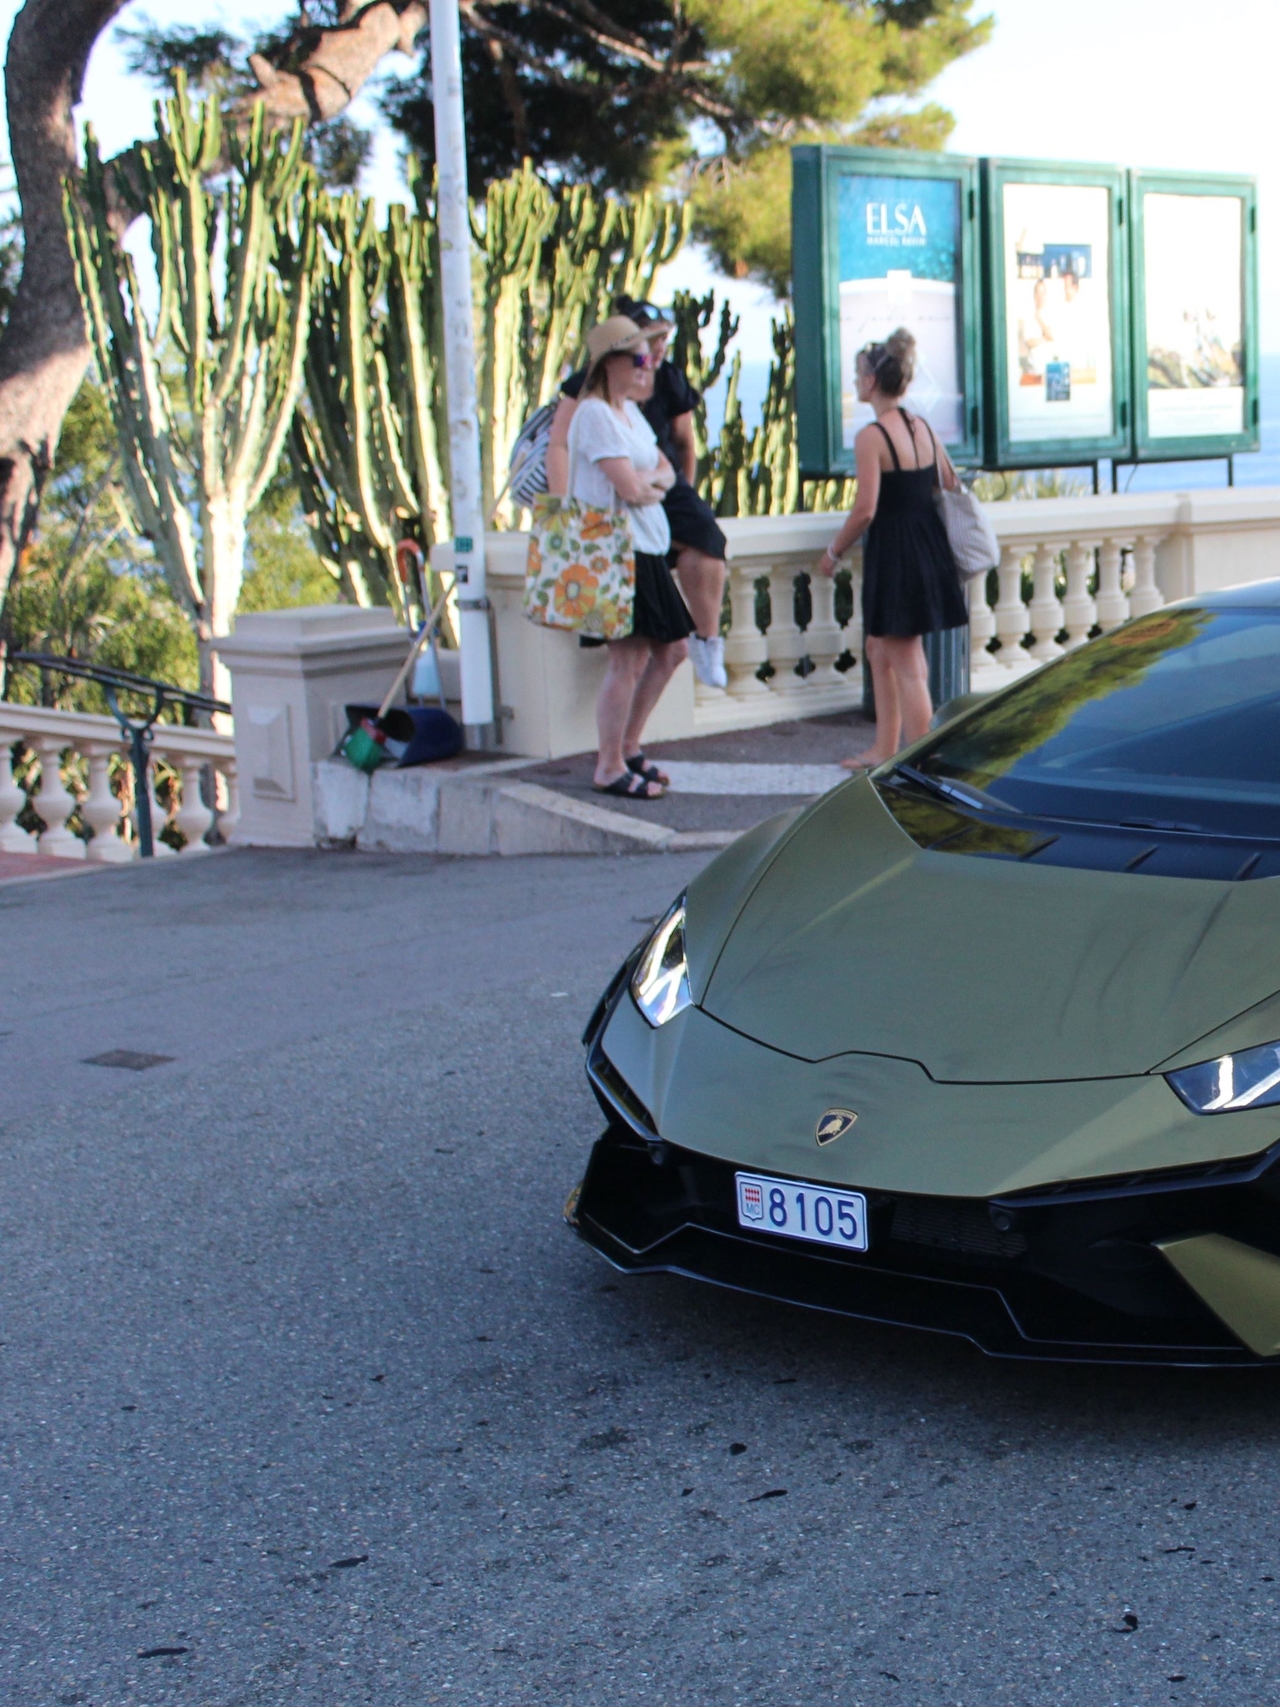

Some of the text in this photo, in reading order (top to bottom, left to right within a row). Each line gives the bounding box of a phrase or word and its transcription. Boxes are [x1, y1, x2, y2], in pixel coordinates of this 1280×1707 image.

[866, 203, 927, 235] ELSA
[746, 1203, 760, 1215] MC
[769, 1187, 857, 1240] 8105
